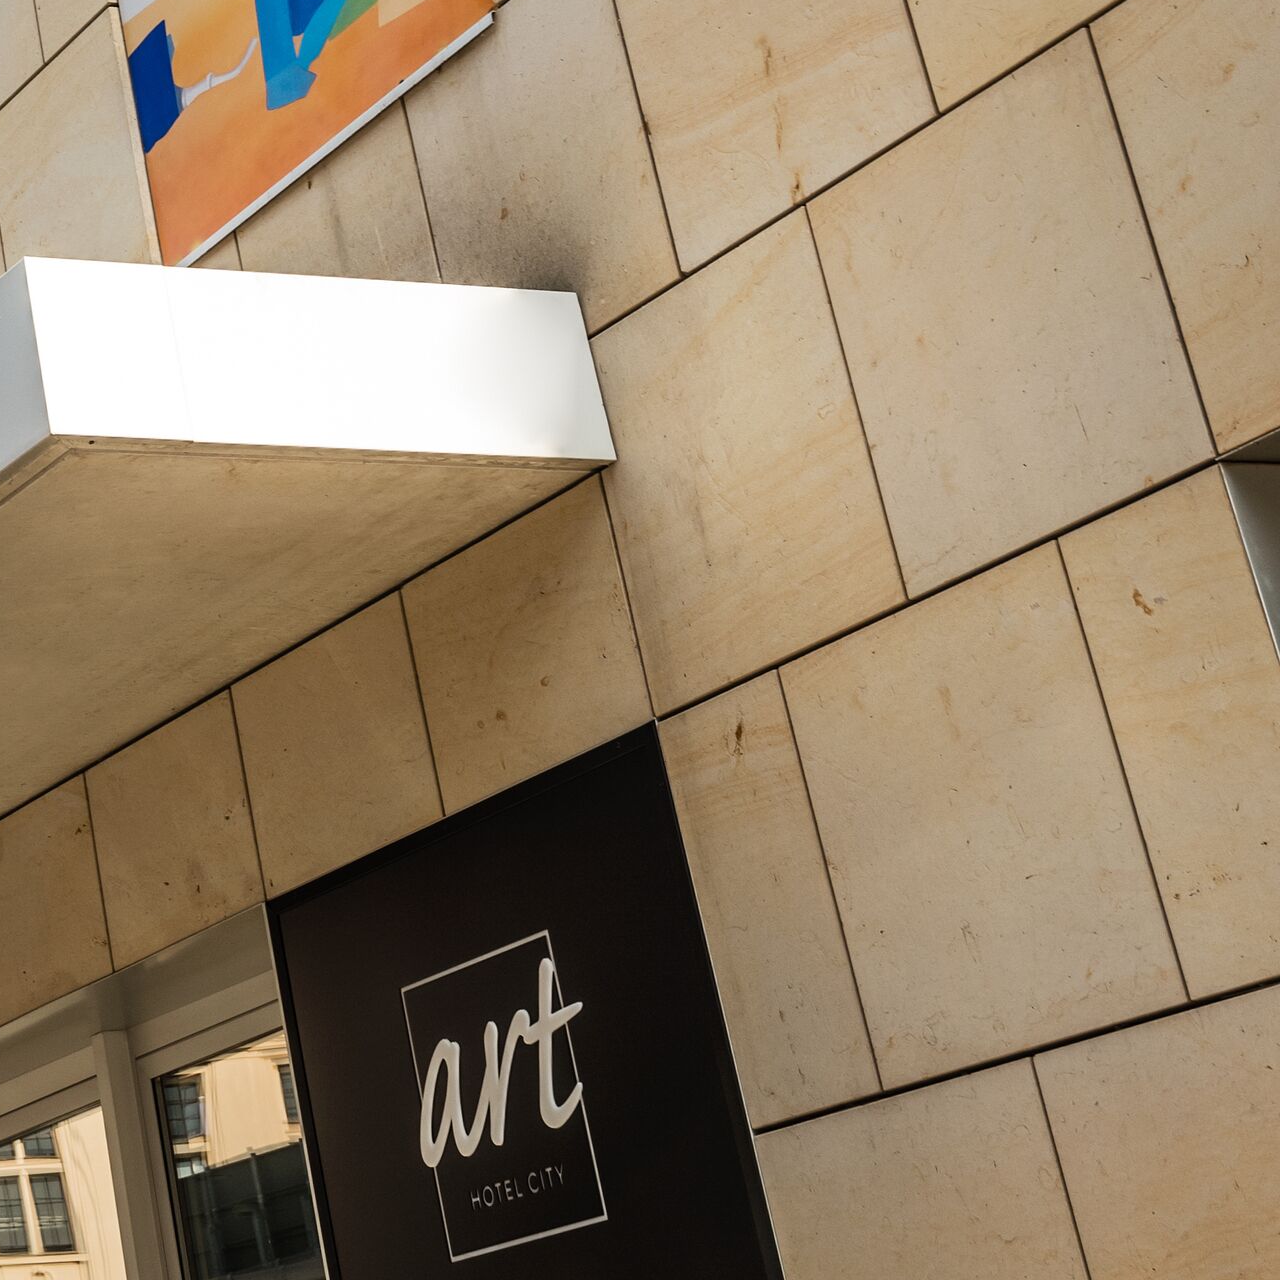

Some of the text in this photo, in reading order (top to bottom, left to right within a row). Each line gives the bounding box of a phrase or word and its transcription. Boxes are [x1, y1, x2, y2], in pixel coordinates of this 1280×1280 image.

[420, 957, 584, 1168] art
[470, 1163, 564, 1210] HOTEL CITY
